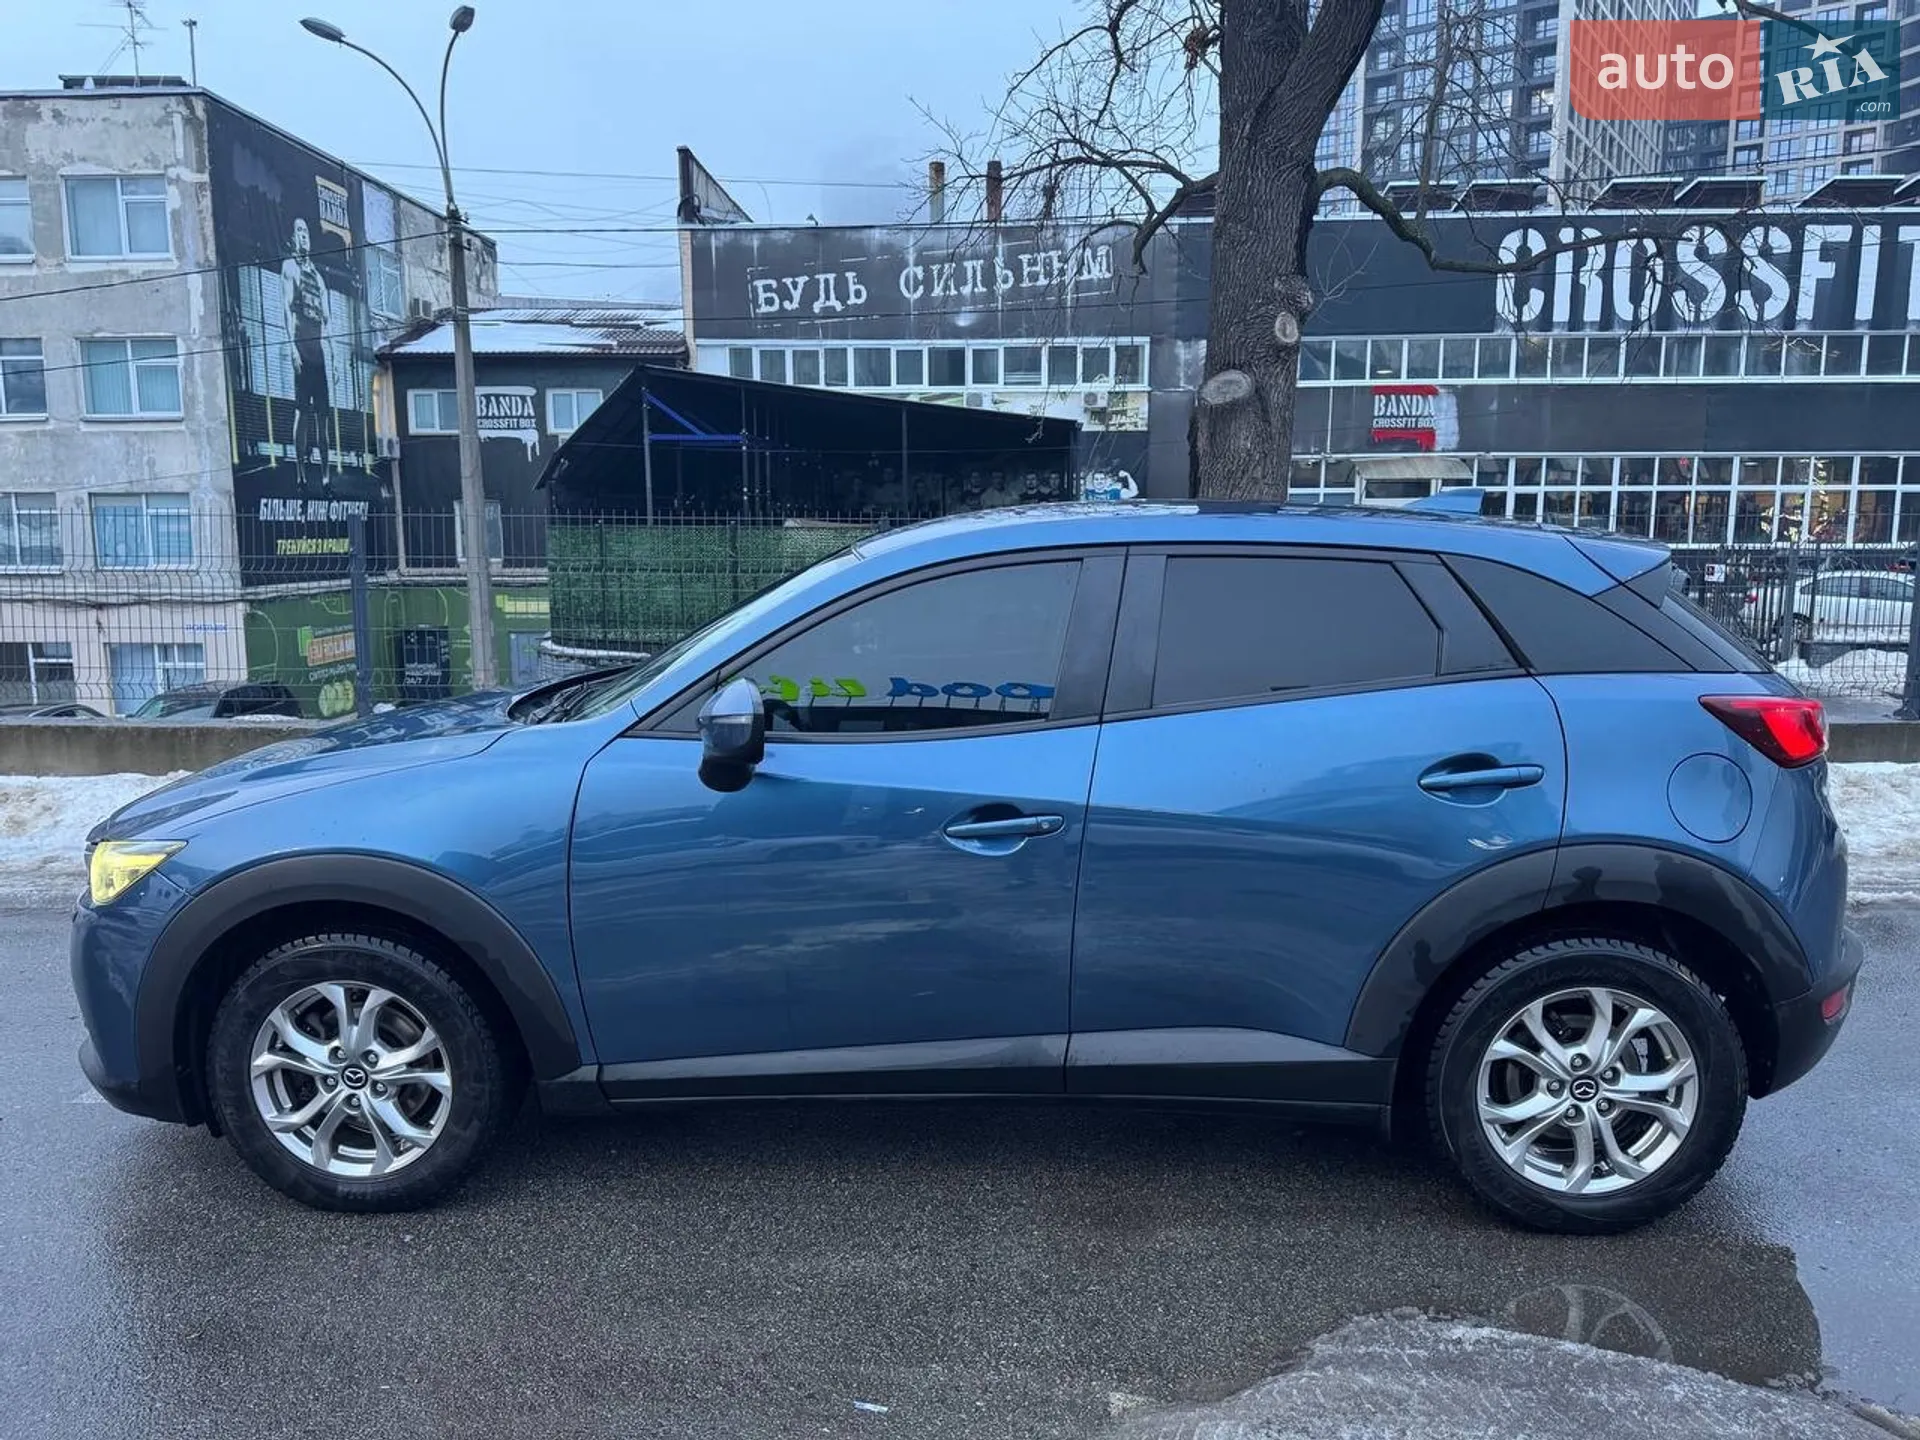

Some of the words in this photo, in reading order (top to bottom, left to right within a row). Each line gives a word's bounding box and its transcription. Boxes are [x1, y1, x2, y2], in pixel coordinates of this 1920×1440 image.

[752, 271, 868, 314] БУДЬ
[475, 395, 536, 417] BANDA
[1373, 394, 1435, 416] BANDA
[476, 417, 518, 429] CROSSFIT
[518, 417, 537, 429] BOX
[1372, 417, 1416, 429] CROSSFIT
[1417, 417, 1436, 429] BOX
[259, 498, 305, 523] БІЛЬШЕ,
[306, 499, 329, 521] НІЖ
